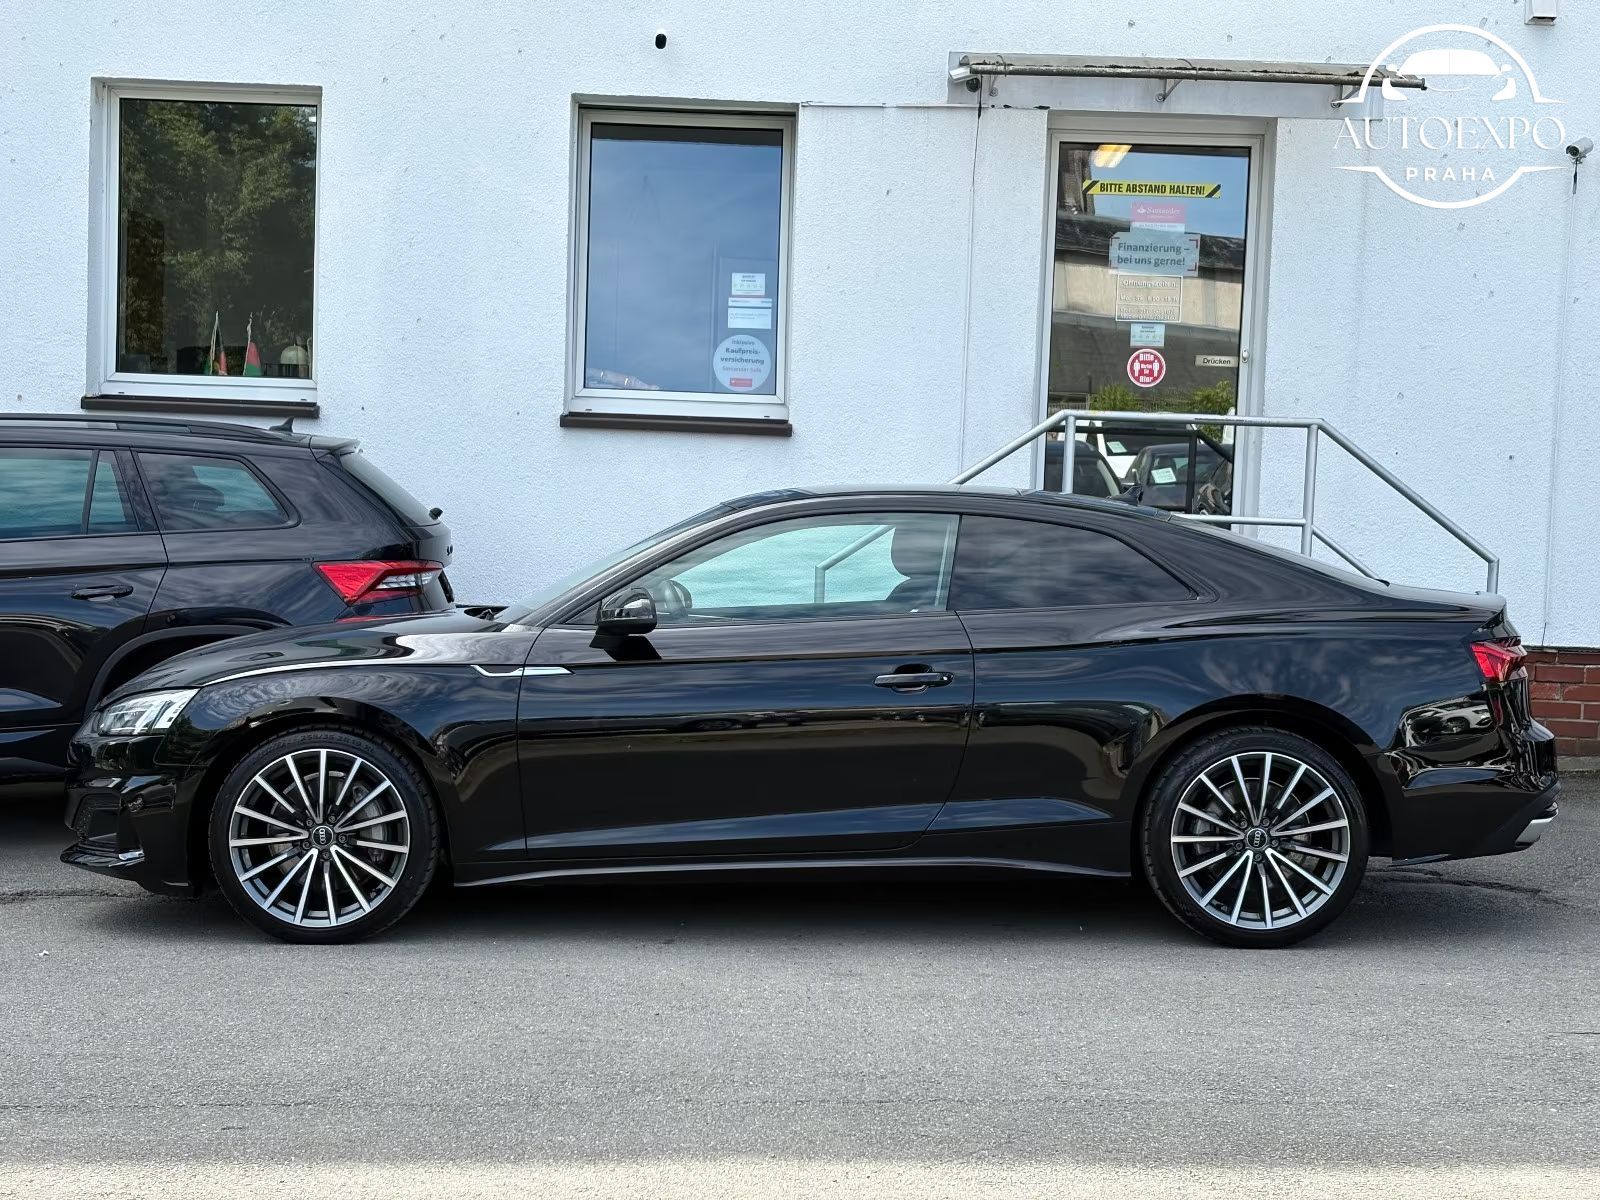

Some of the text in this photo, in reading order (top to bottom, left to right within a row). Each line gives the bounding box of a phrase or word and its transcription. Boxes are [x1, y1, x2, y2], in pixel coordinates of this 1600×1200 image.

[1100, 183, 1205, 195] BITTE ABSTAND HALTEN!
[1118, 243, 1182, 255] Finanzierung
[1117, 255, 1185, 268] bei uns gerne!
[1202, 357, 1231, 365] Drücken
